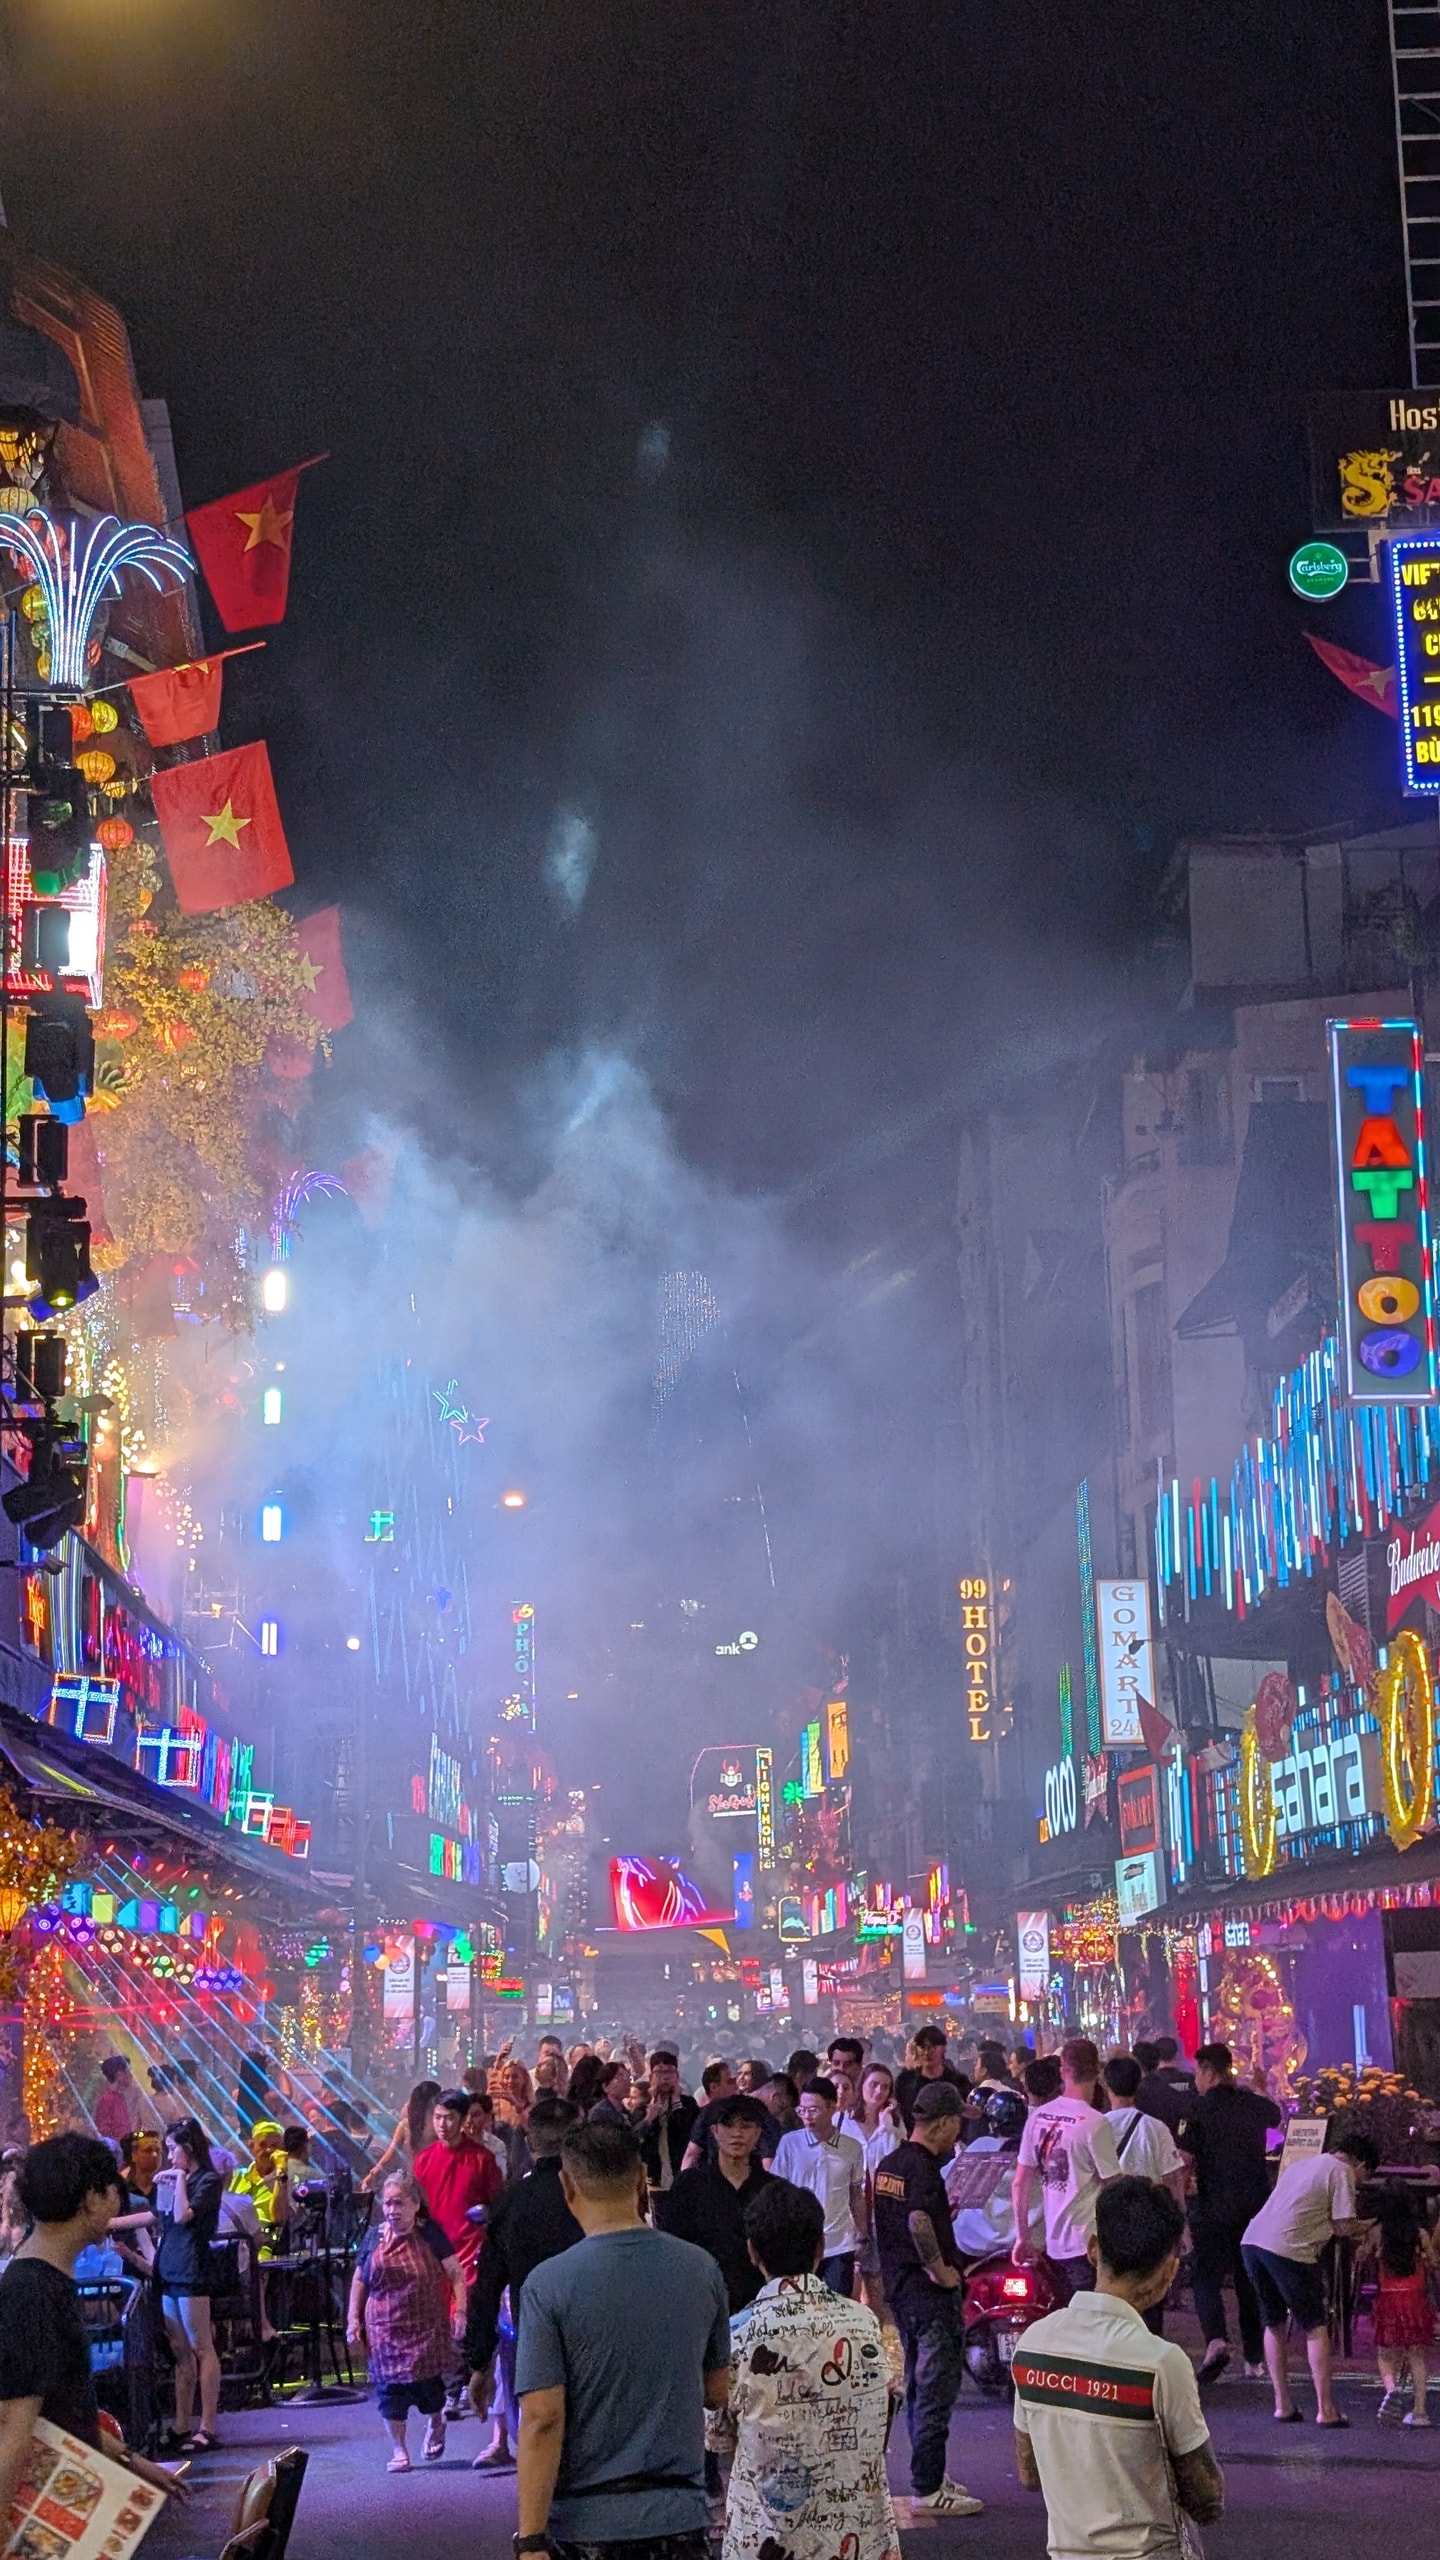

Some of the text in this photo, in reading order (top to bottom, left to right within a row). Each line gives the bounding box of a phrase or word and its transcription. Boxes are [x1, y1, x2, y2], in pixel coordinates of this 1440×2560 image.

[1389, 398, 1440, 431] Hos
[1296, 559, 1342, 576] Carlsberg
[1346, 1064, 1420, 1378] TATTOO
[959, 1578, 987, 1600] 99
[962, 1605, 990, 1741] HOTEL
[1110, 1586, 1141, 1714] GOMART
[1271, 1731, 1367, 1837] sahara
[1026, 2369, 1118, 2400] GUCCI 1921
